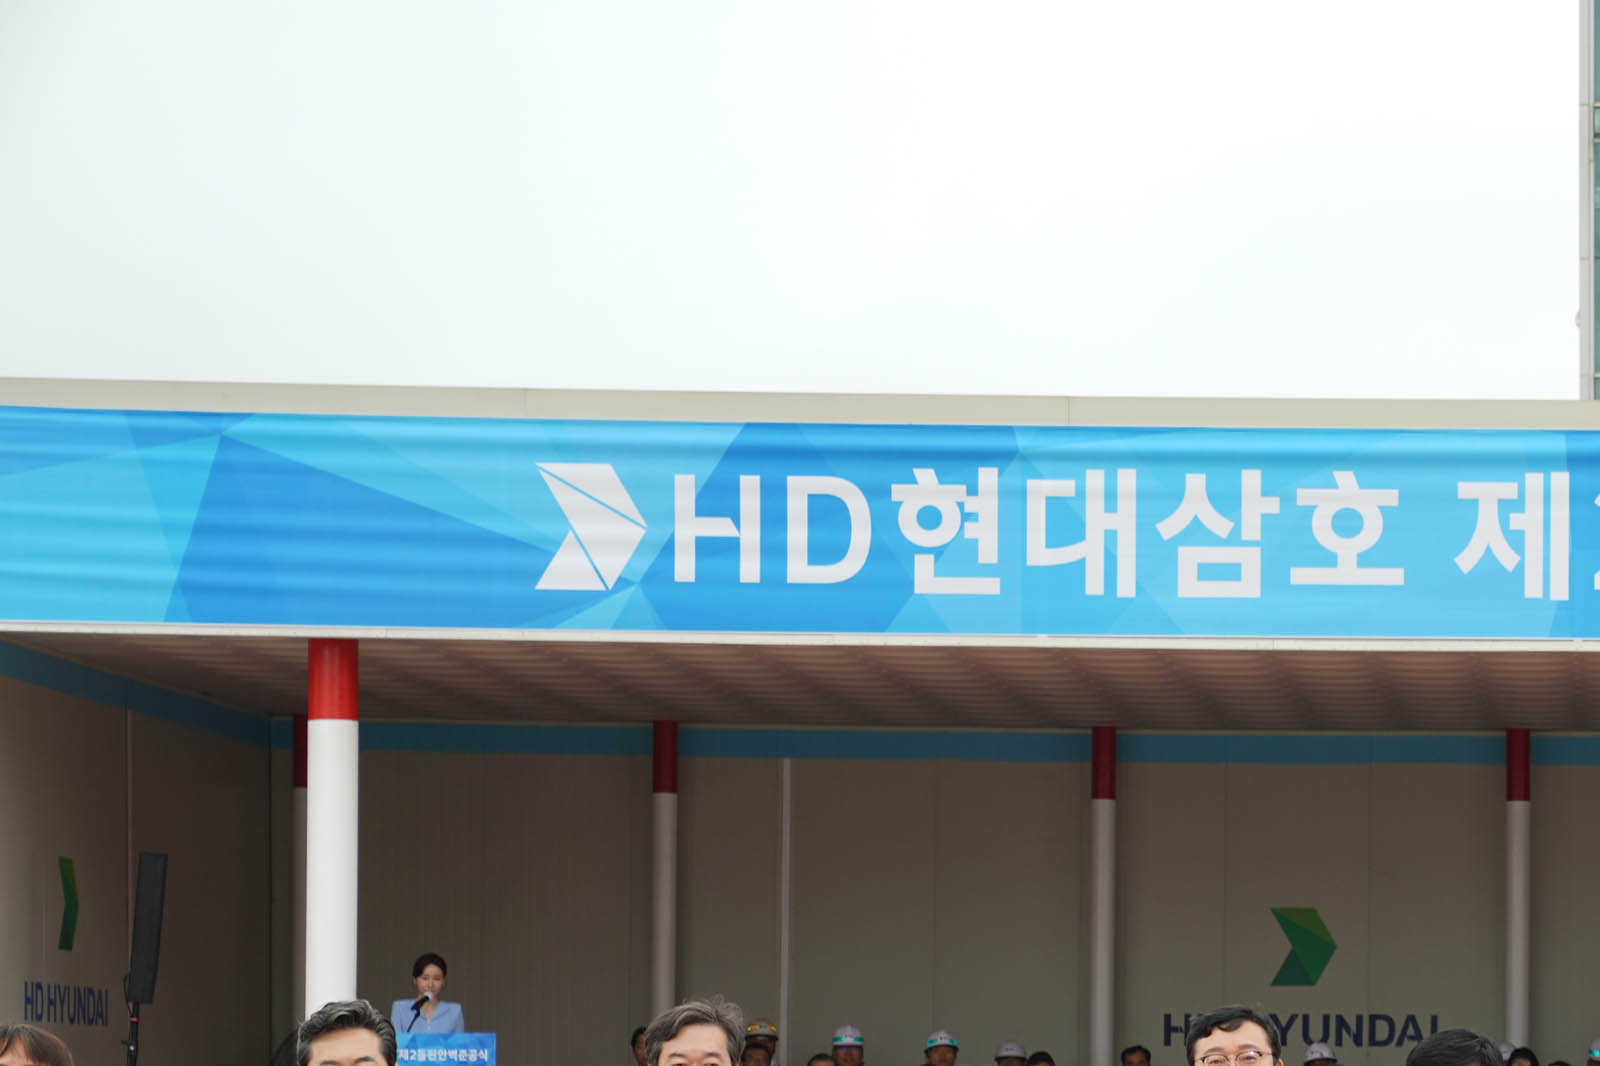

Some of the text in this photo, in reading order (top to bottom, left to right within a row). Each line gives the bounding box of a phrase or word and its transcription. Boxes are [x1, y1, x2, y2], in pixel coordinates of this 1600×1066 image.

[672, 466, 1405, 601] HD현대삼호
[24, 980, 109, 1028] HD HYUNDAI
[1163, 1013, 1438, 1048] H YUNDAI
